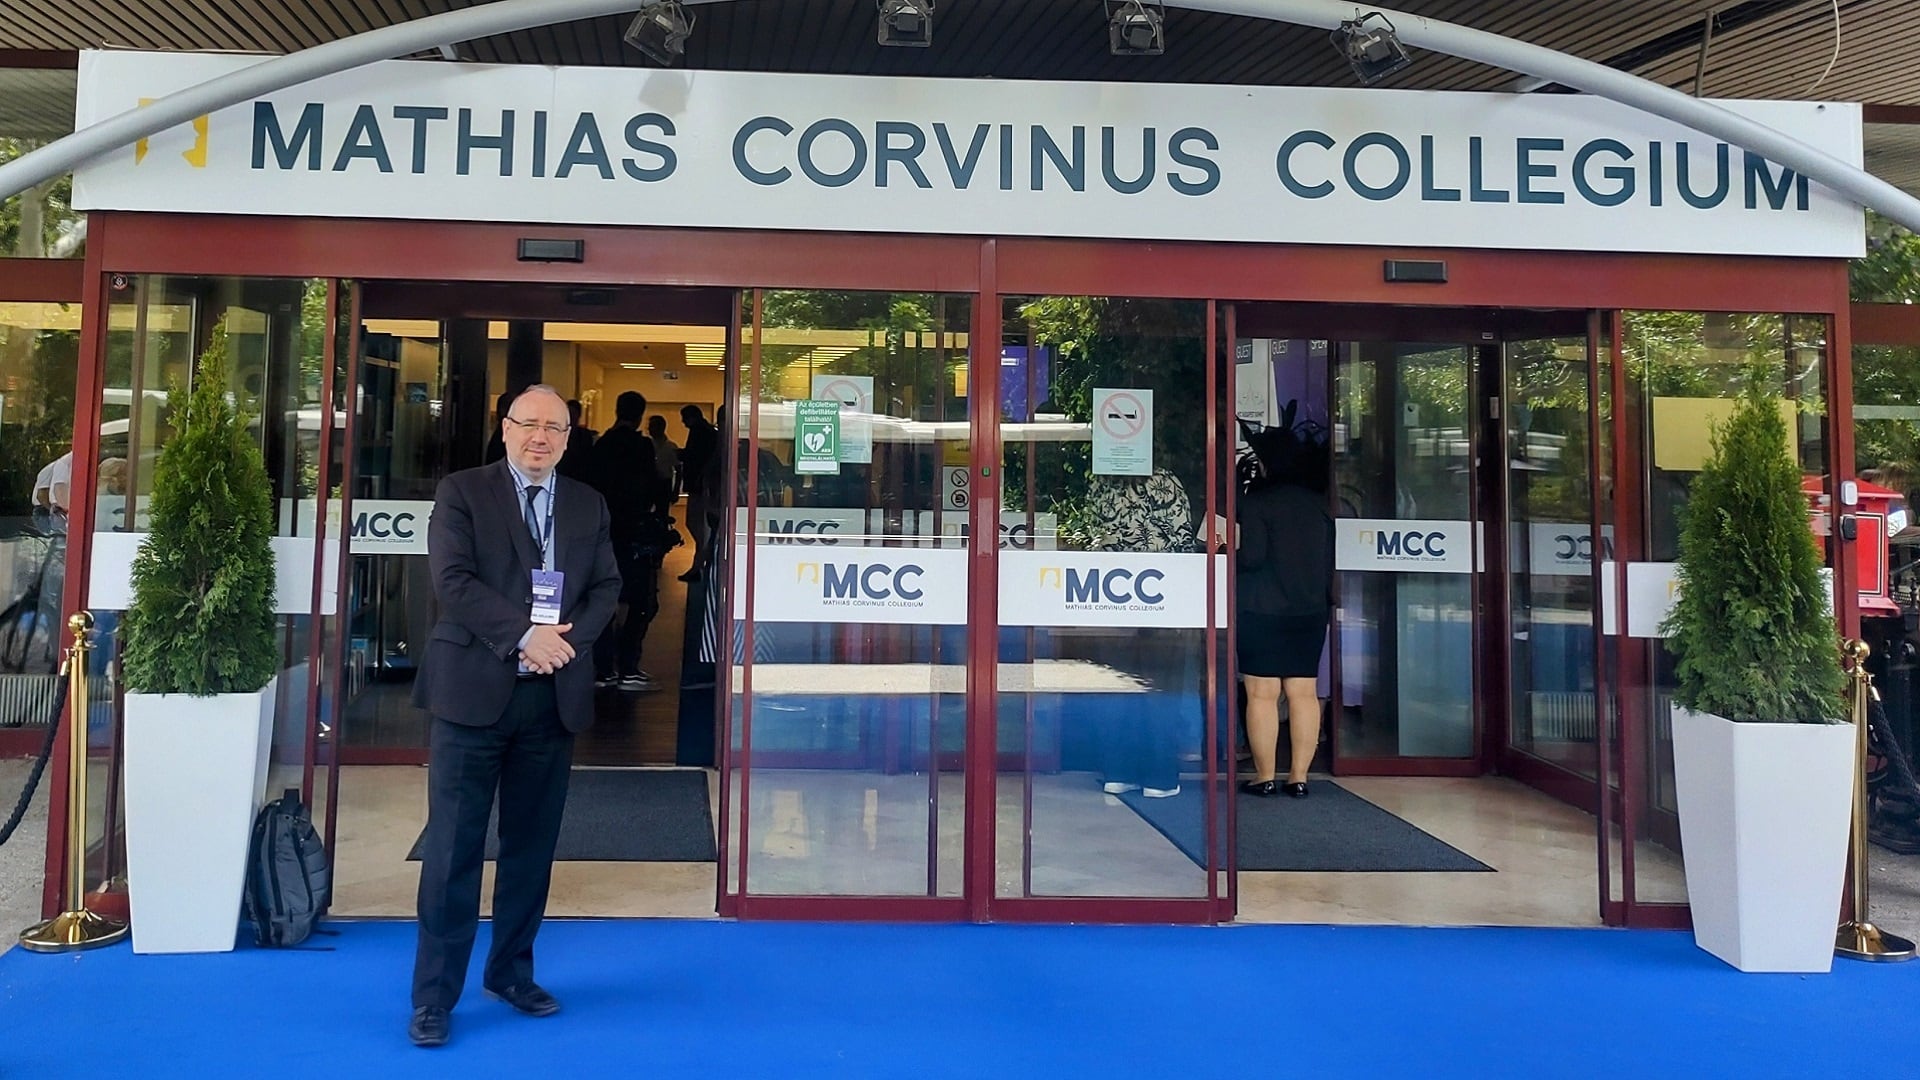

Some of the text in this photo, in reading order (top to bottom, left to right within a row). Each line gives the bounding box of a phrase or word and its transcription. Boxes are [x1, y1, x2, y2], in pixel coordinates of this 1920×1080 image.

[251, 101, 1809, 211] MATHIAS CORVINUS COLLEGIUM
[768, 519, 840, 545] MCC
[1377, 531, 1446, 557] MCC
[823, 563, 924, 600] MCC
[1066, 568, 1165, 604] MCC
